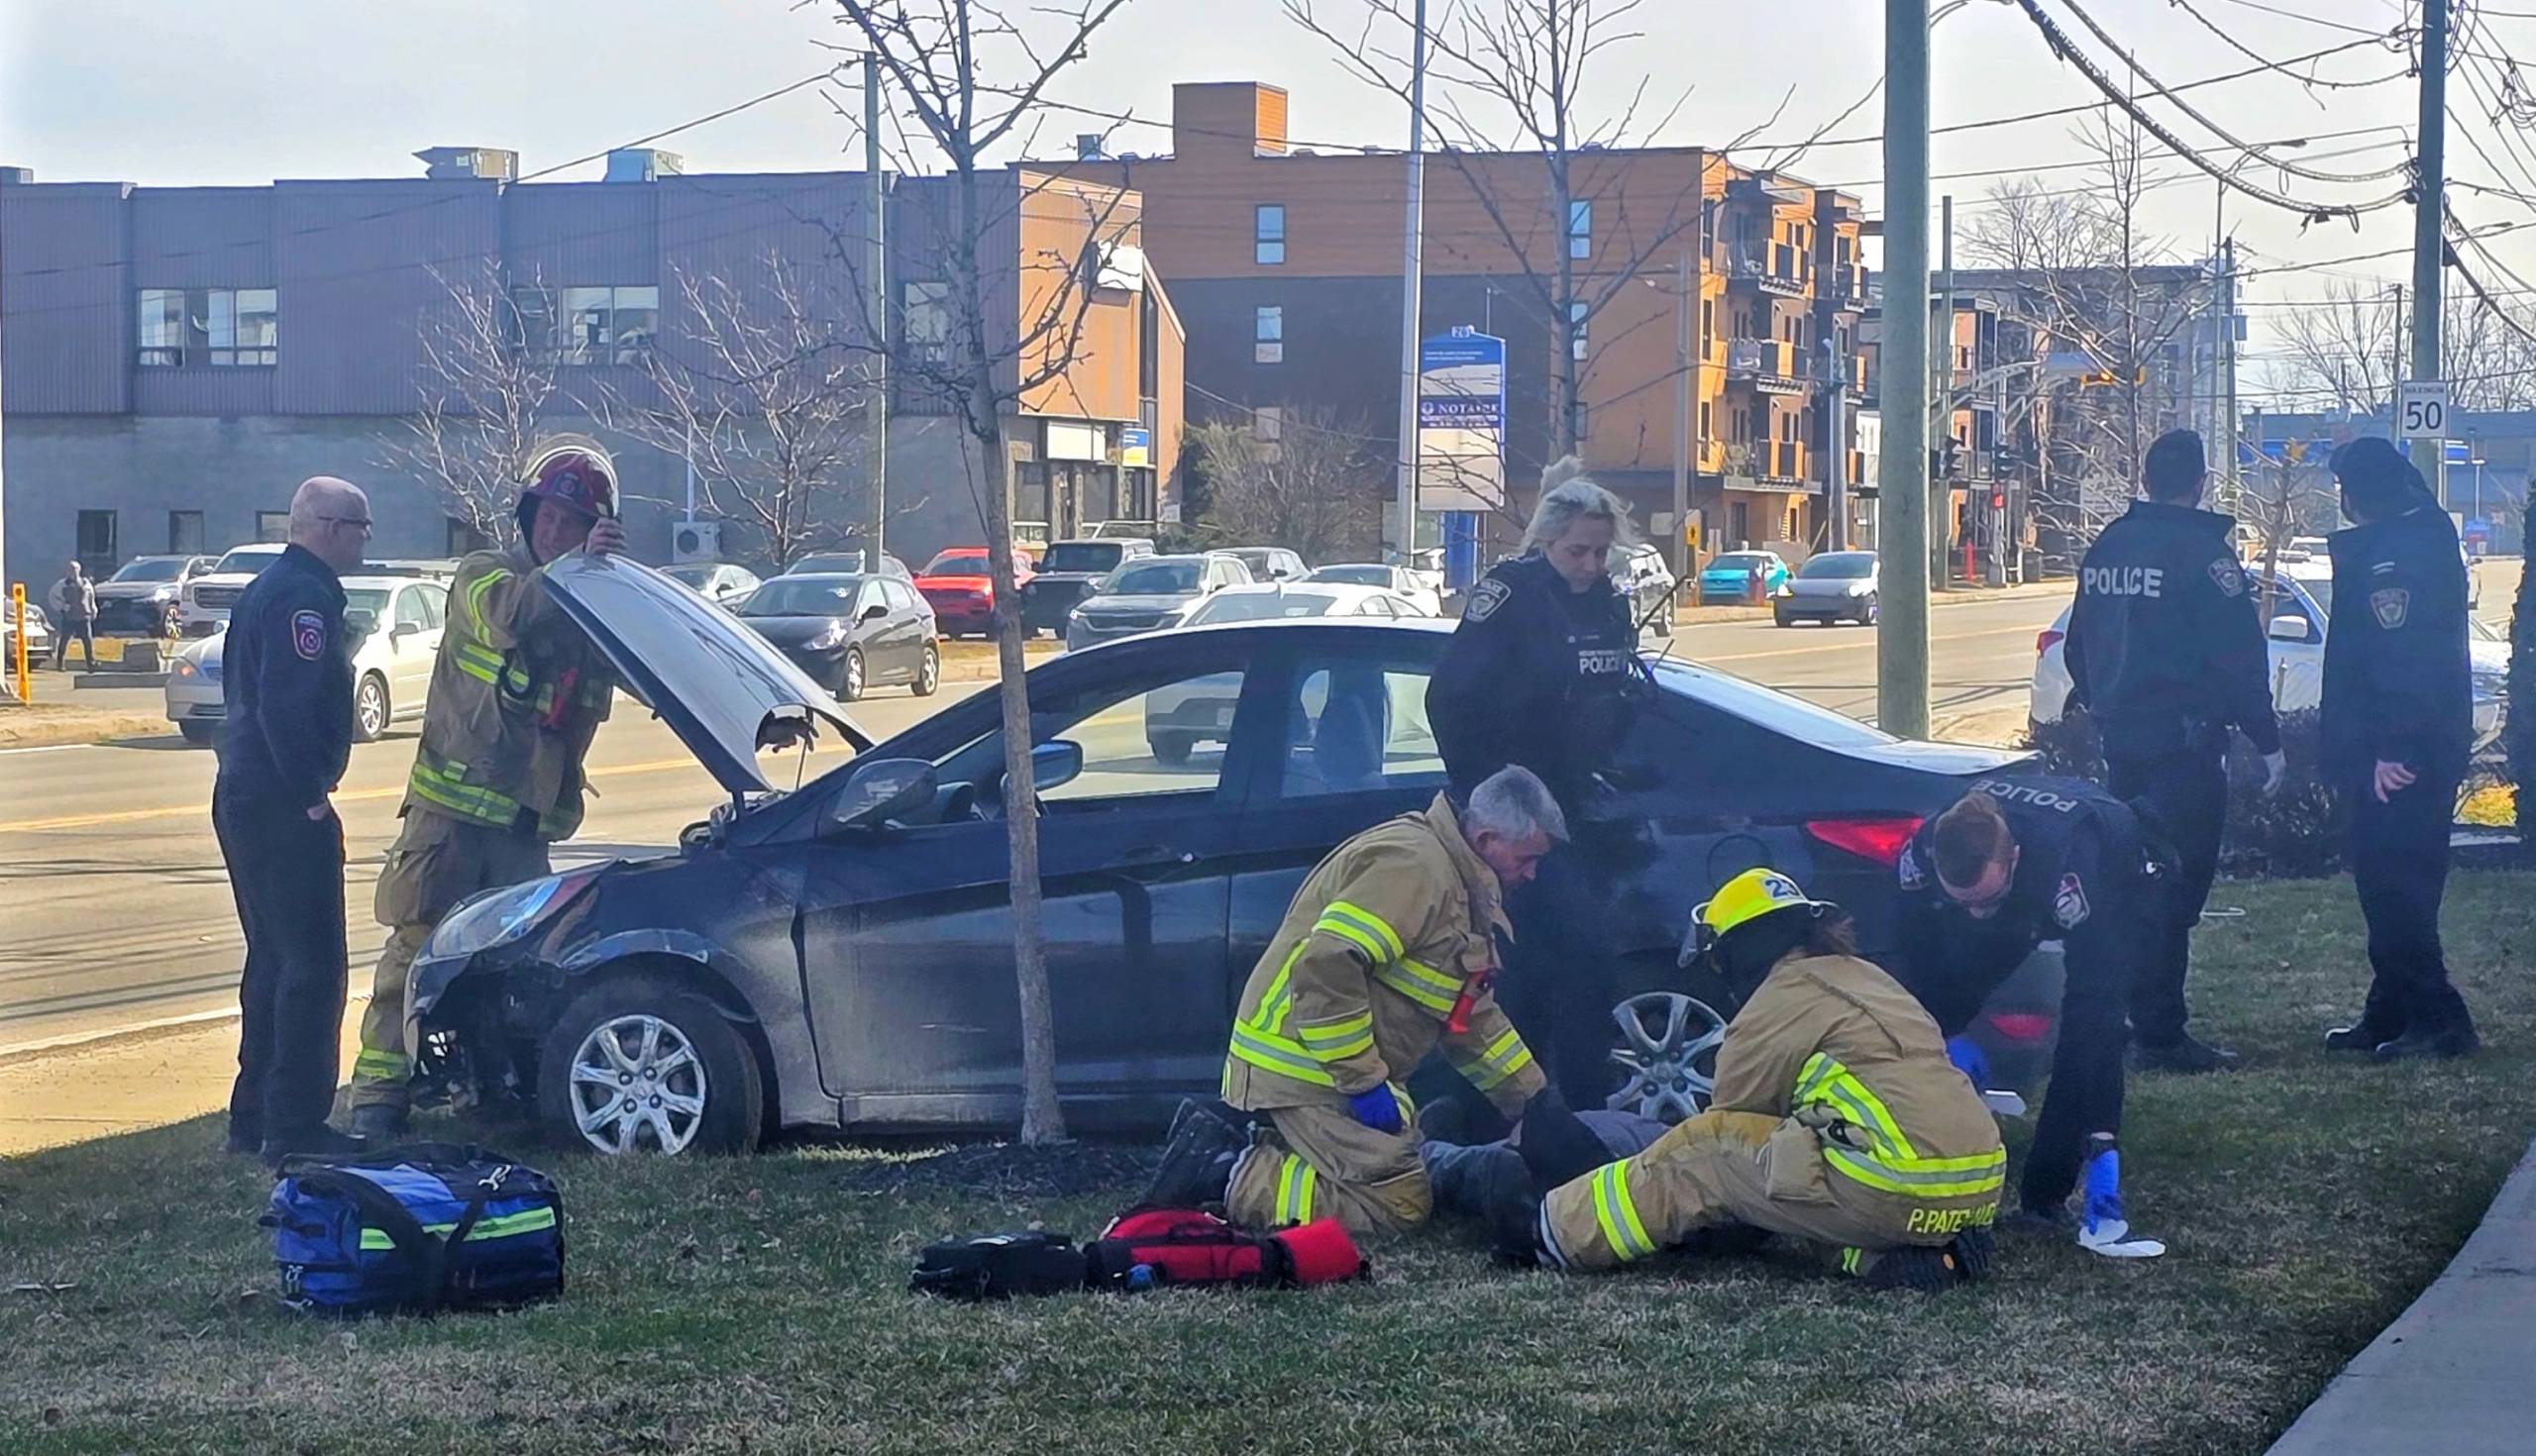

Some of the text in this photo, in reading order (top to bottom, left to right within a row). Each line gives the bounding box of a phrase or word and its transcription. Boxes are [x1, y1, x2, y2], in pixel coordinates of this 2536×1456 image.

[2405, 401, 2443, 431] 50
[2083, 566, 2164, 598] POLICE
[1969, 780, 2078, 812] POLICE
